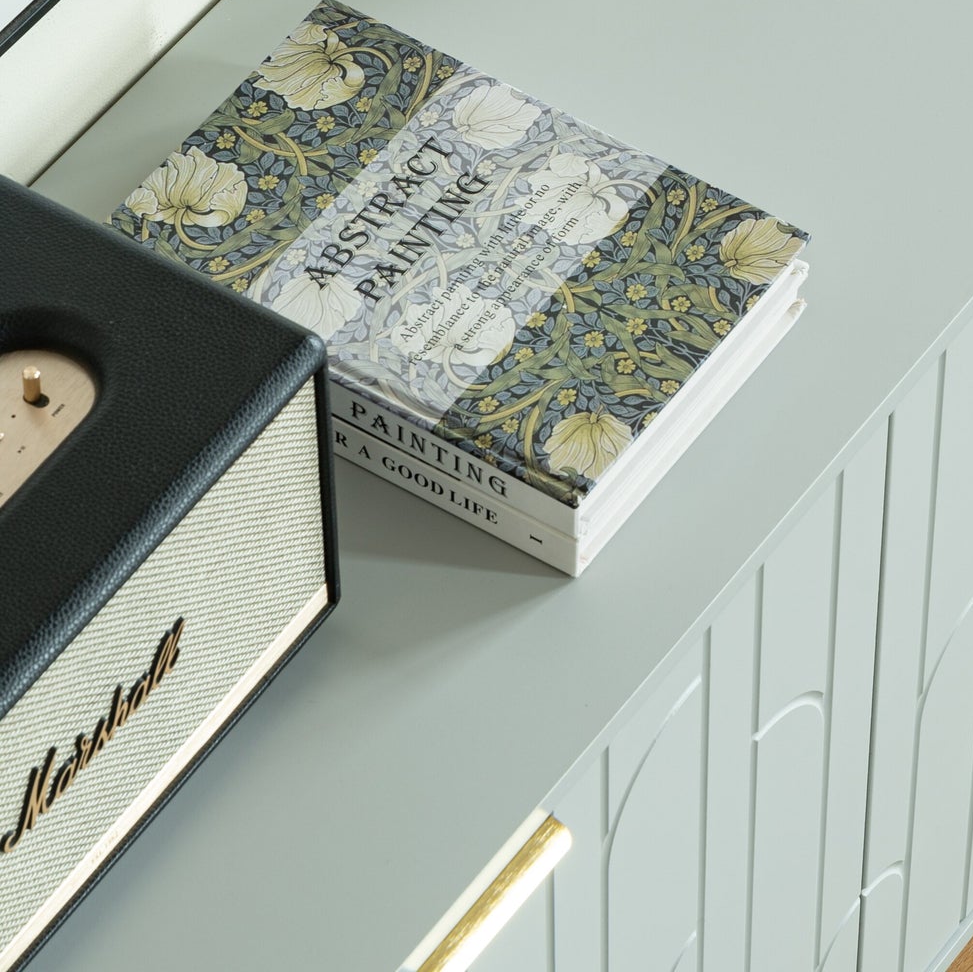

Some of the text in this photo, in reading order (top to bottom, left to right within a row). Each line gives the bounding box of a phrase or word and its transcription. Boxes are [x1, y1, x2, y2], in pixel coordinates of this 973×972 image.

[304, 136, 451, 291] ABSTRACT
[353, 171, 492, 304] PAINTING
[400, 183, 550, 343] Abstract painting with little or no
[408, 181, 583, 366] resemblance to the natural image, with
[453, 216, 580, 351] a strong appearance of form
[350, 400, 509, 499] PAINTING
[358, 445, 372, 461] A
[381, 455, 445, 497] GOOD
[449, 488, 499, 526] LIFE
[2, 617, 186, 854] Marshall
